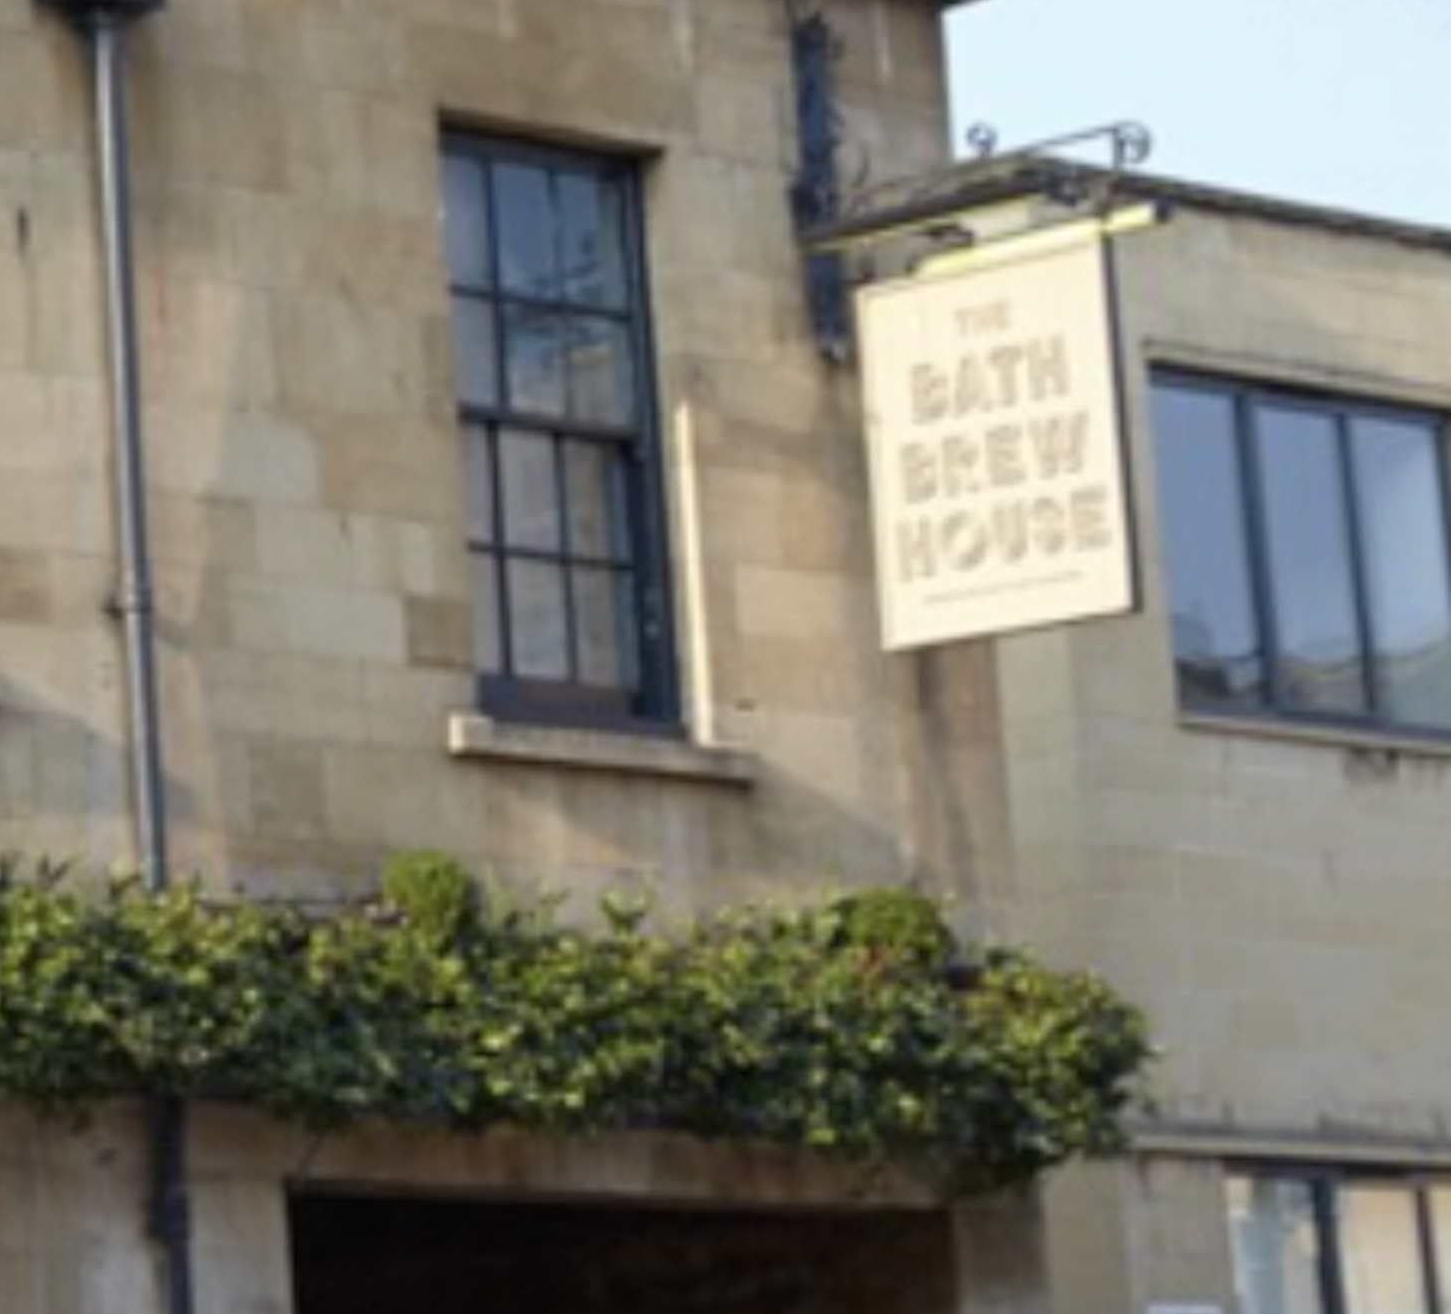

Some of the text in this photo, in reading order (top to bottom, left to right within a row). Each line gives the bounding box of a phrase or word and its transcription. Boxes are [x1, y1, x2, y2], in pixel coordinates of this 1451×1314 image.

[953, 300, 1010, 335] THE
[909, 335, 1070, 426] BATH
[898, 410, 1089, 507] BREW
[894, 486, 1114, 582] HOUSE
